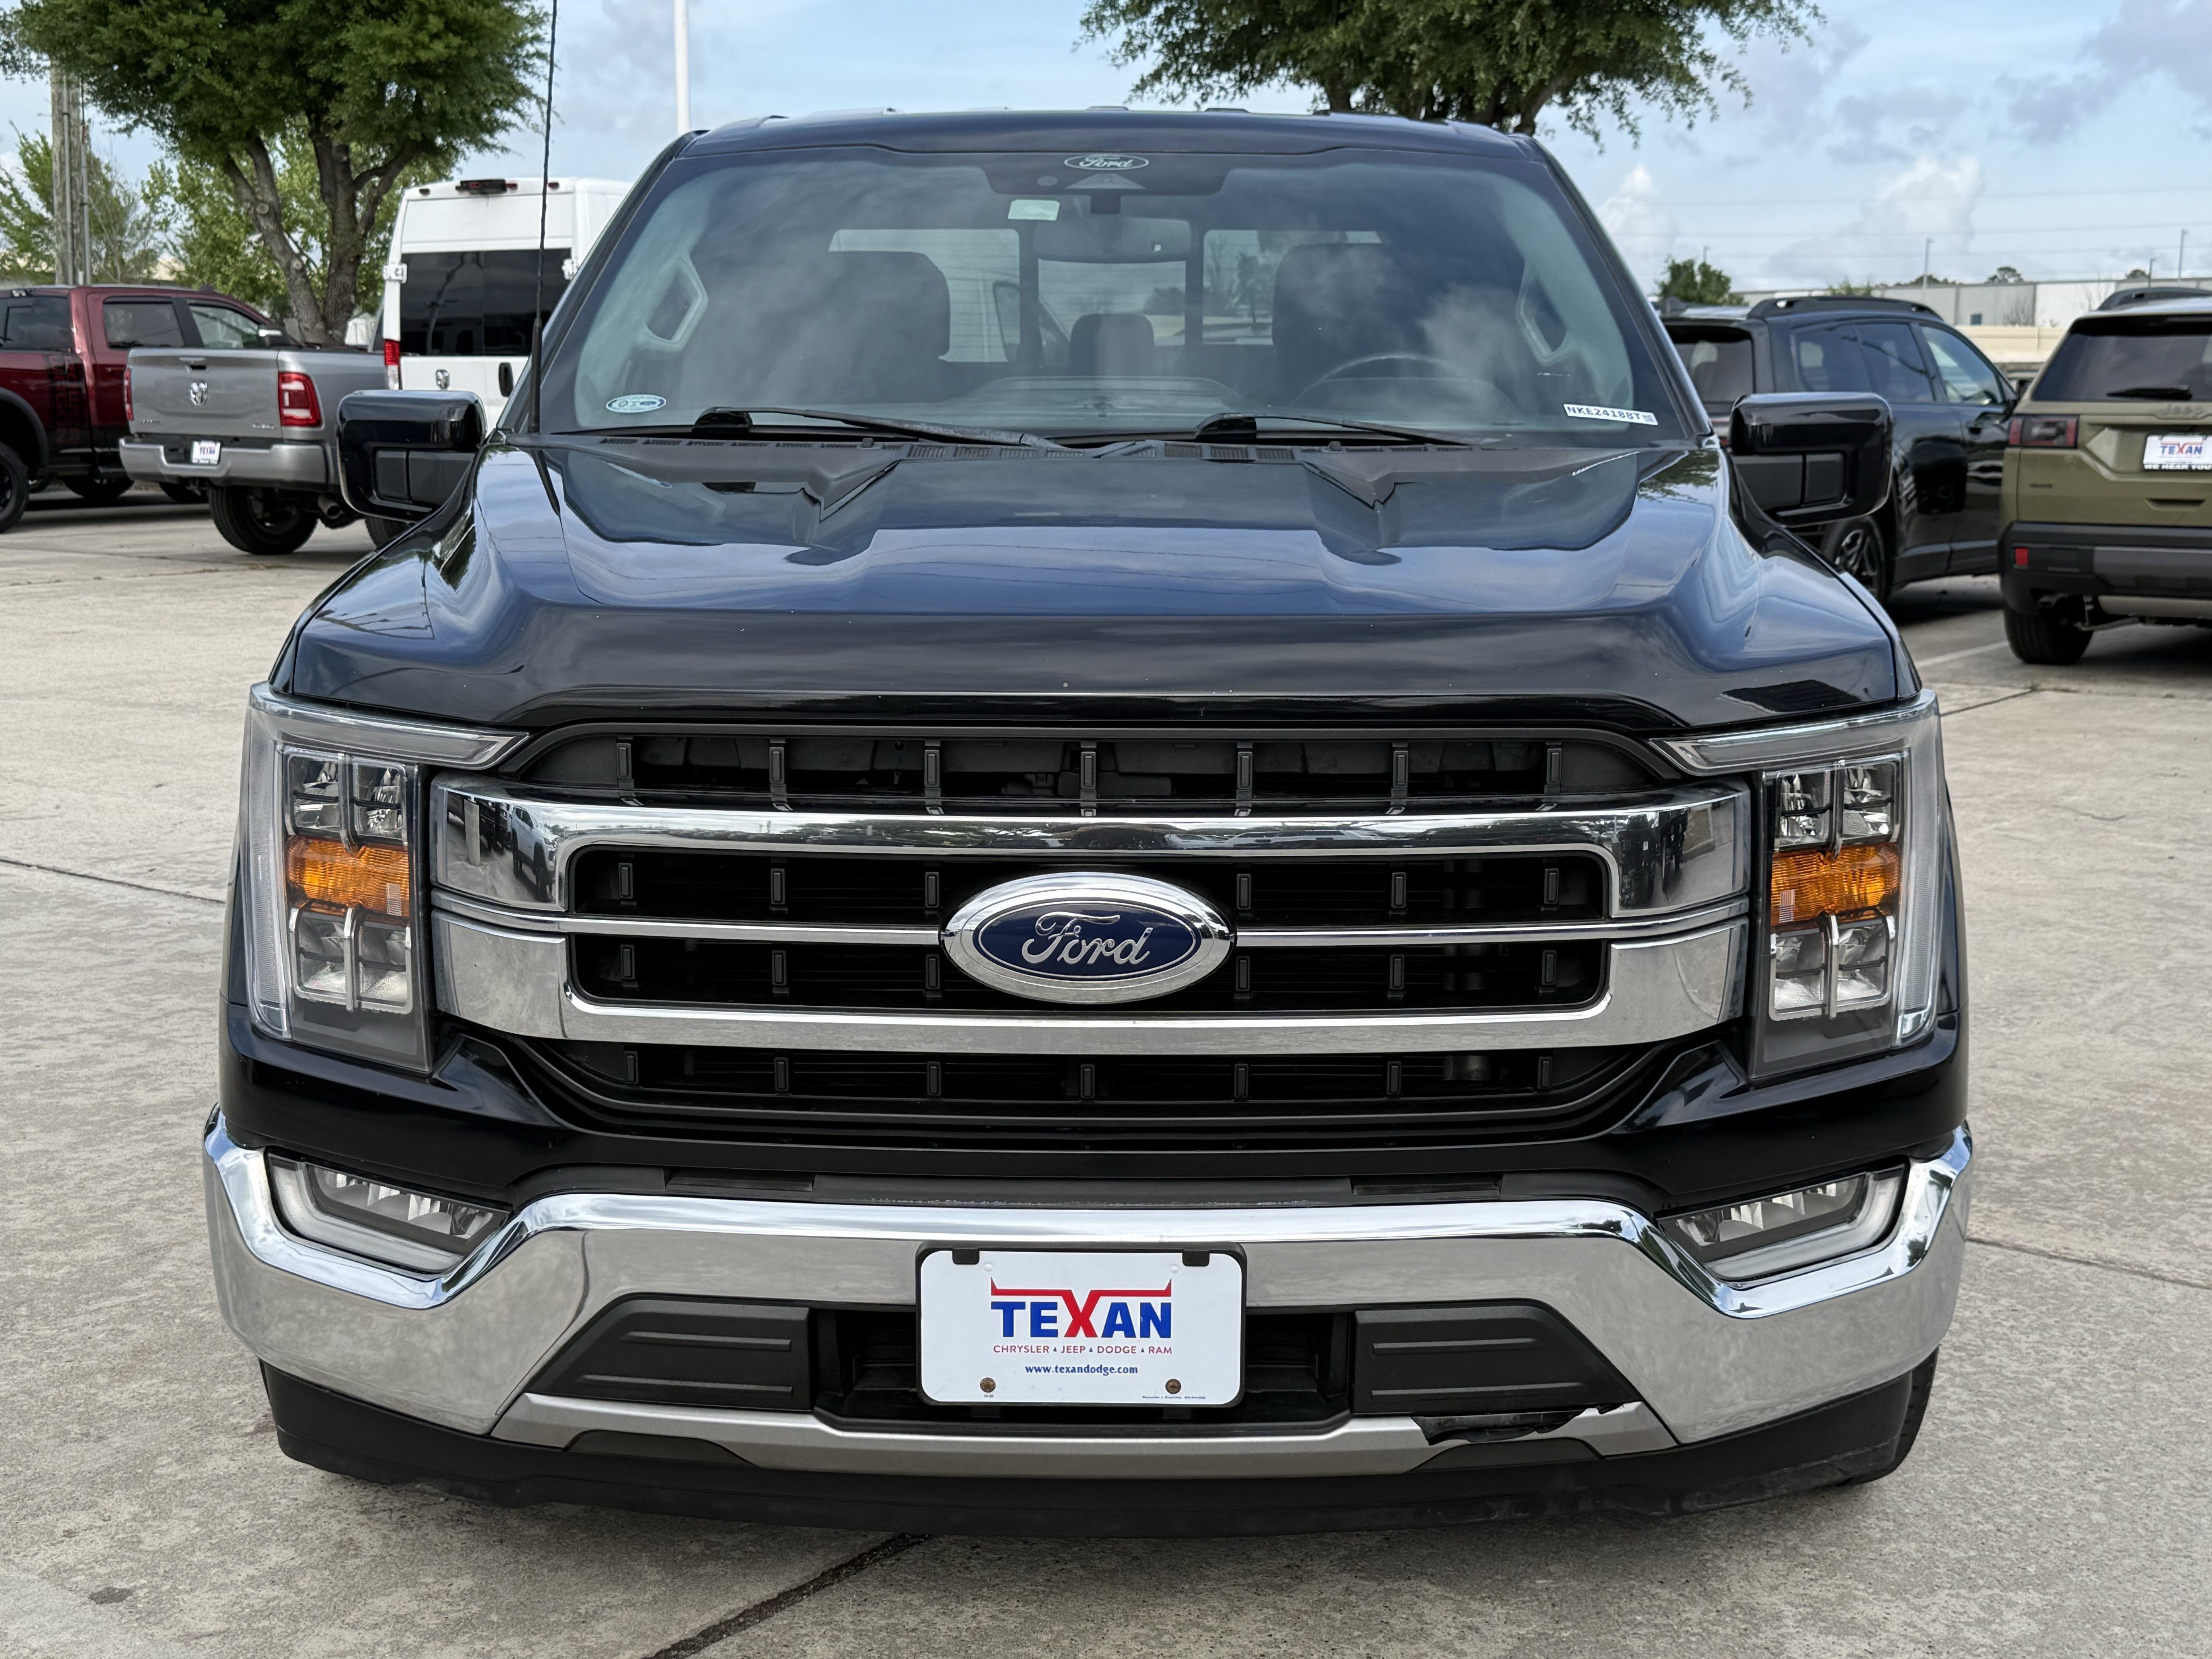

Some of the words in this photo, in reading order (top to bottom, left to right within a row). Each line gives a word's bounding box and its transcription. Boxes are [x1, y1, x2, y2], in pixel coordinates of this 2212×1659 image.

[1079, 155, 1133, 168] Ford
[2160, 443, 2203, 455] TEXAN
[1022, 911, 1153, 965] Ford
[991, 1290, 1172, 1339] TEXAN
[993, 1345, 1049, 1354] CHRYSLER
[1060, 1345, 1086, 1354] JEEP
[1097, 1345, 1137, 1354] DODGE
[1148, 1346, 1172, 1355] RAM
[1025, 1364, 1138, 1376] www.texandodge.com
